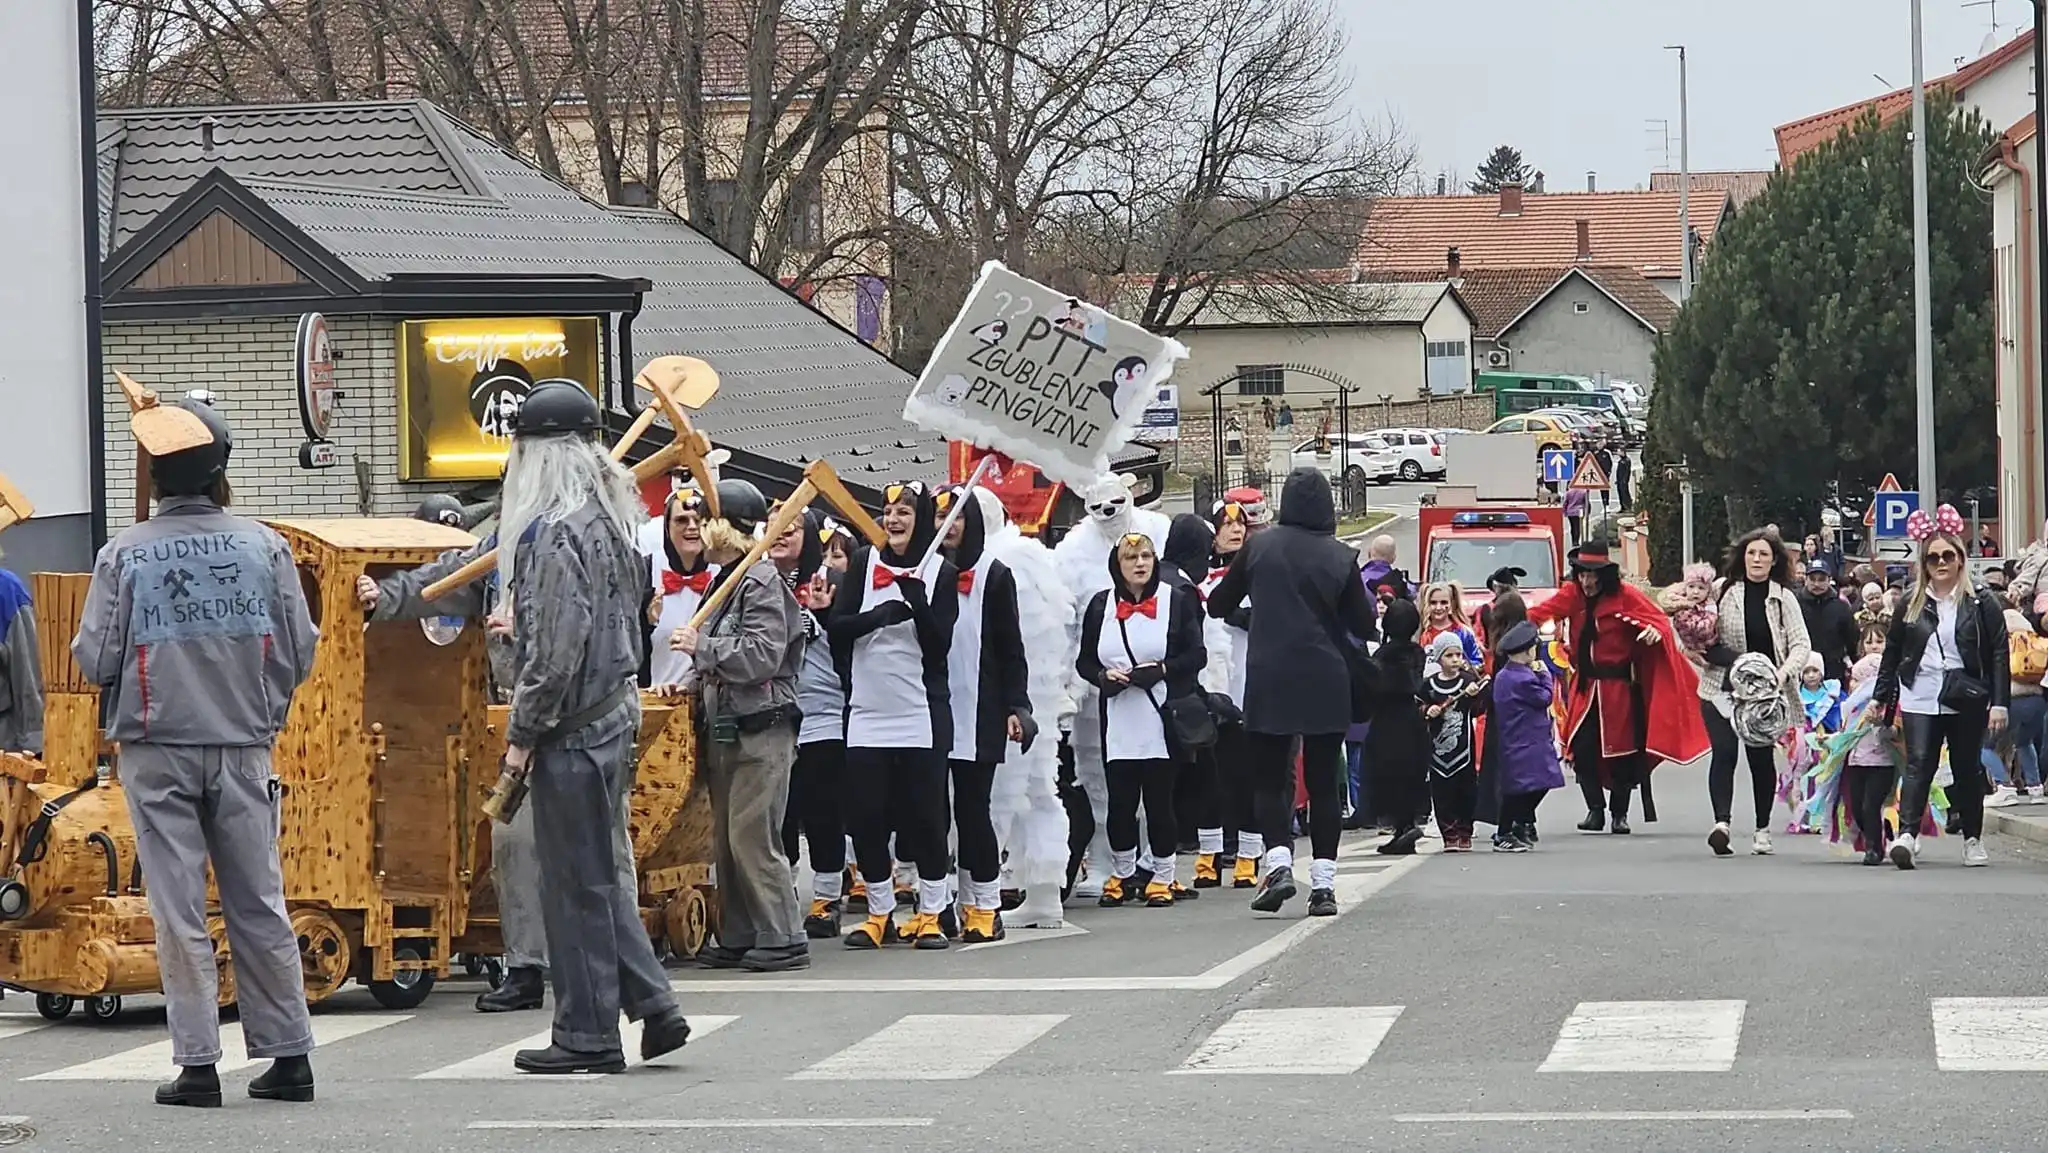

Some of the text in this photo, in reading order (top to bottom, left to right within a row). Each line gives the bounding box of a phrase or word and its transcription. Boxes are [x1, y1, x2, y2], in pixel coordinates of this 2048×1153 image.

[521, 332, 569, 361] bar
[1016, 315, 1107, 377] PTT
[967, 338, 1099, 411] ZGUBLENI
[480, 389, 527, 445] AR
[965, 376, 1099, 448] PINGVINI
[314, 453, 334, 463] ART
[1886, 500, 1909, 530] P
[1487, 545, 1496, 555] 2
[144, 604, 169, 630] M.
